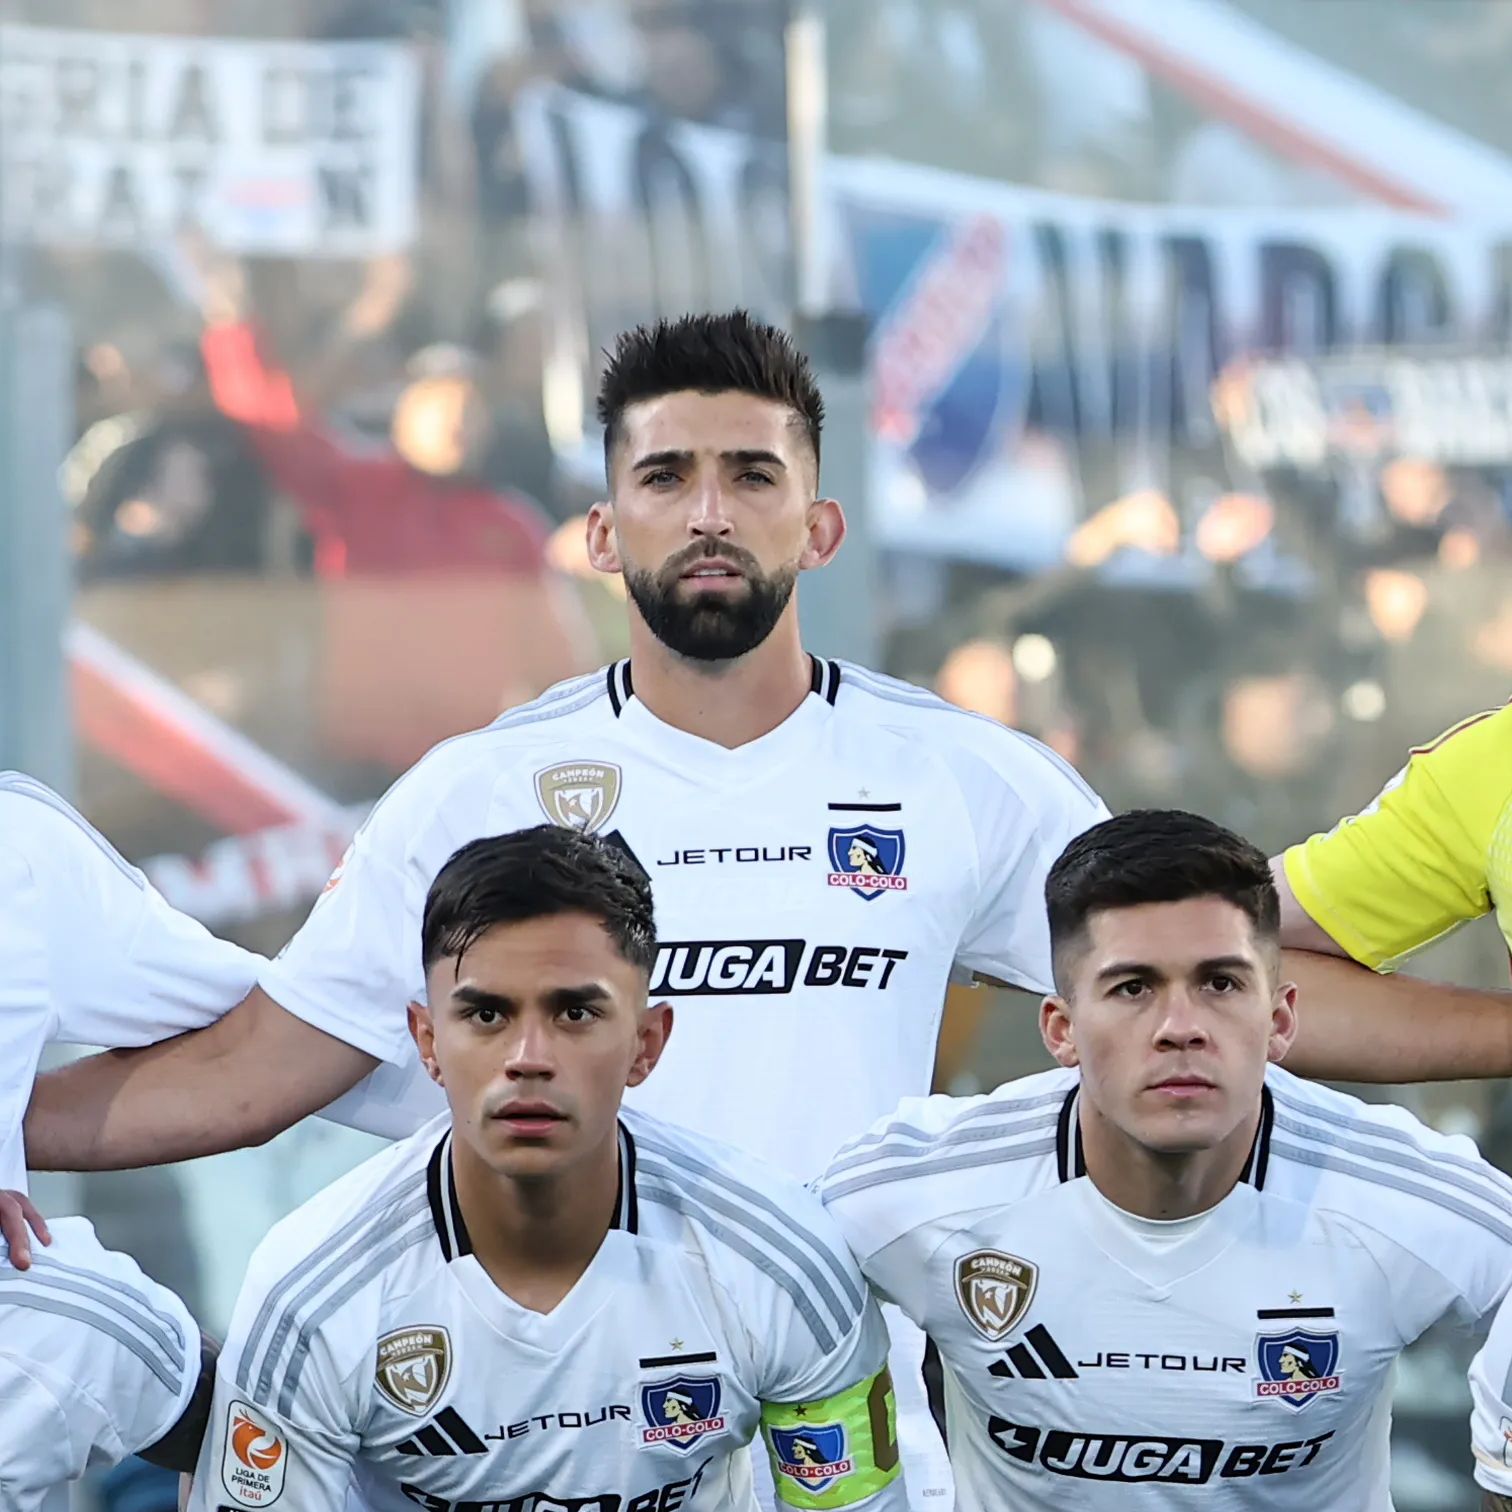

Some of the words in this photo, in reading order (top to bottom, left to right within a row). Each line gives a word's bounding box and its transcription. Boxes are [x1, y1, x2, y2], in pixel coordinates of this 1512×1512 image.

[552, 768, 604, 782] CAMPEÓN
[657, 846, 812, 865] JETOUR
[830, 873, 905, 890] COLO-COLO
[970, 1256, 1022, 1276] CAMPEÓN
[380, 1332, 433, 1357] CAMPEÓN
[1077, 1352, 1247, 1373] JETOUR
[1259, 1377, 1336, 1396] COLO-COLO
[484, 1405, 632, 1441] JETOUR
[646, 1418, 723, 1442] COLO-COLO
[235, 1467, 256, 1480] LIGA
[257, 1473, 270, 1484] DE
[780, 1461, 849, 1477] COLO-COLO
[231, 1475, 272, 1493] PRIMERA
[239, 1485, 262, 1501] itaú
